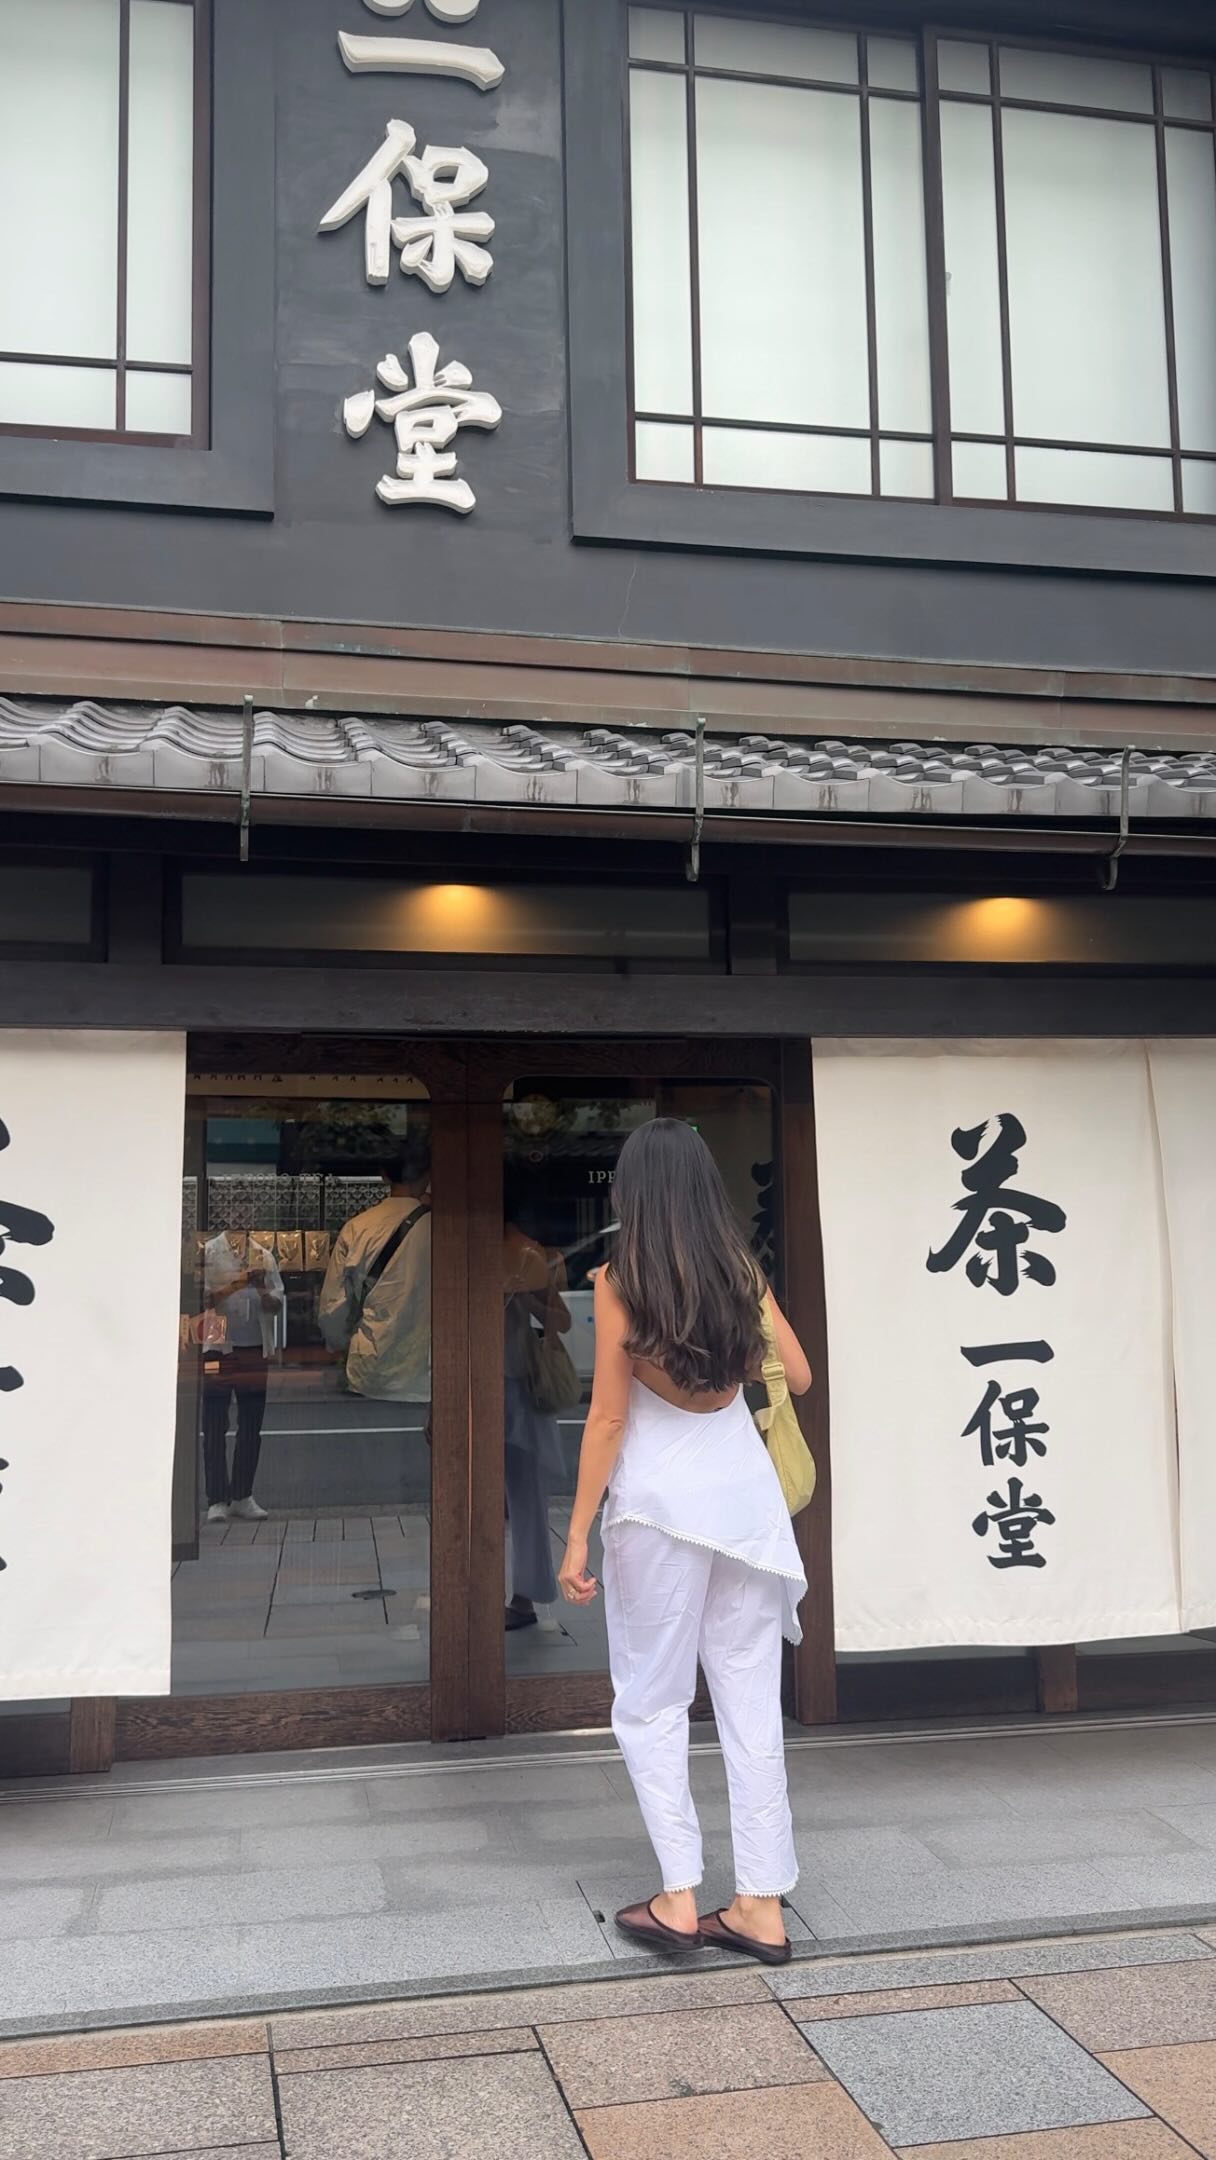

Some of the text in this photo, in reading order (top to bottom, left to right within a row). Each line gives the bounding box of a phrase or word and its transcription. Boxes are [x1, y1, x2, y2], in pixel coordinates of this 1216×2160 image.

[318, 0, 506, 514] 一保堂
[926, 1112, 1067, 1569] 茶一保堂
